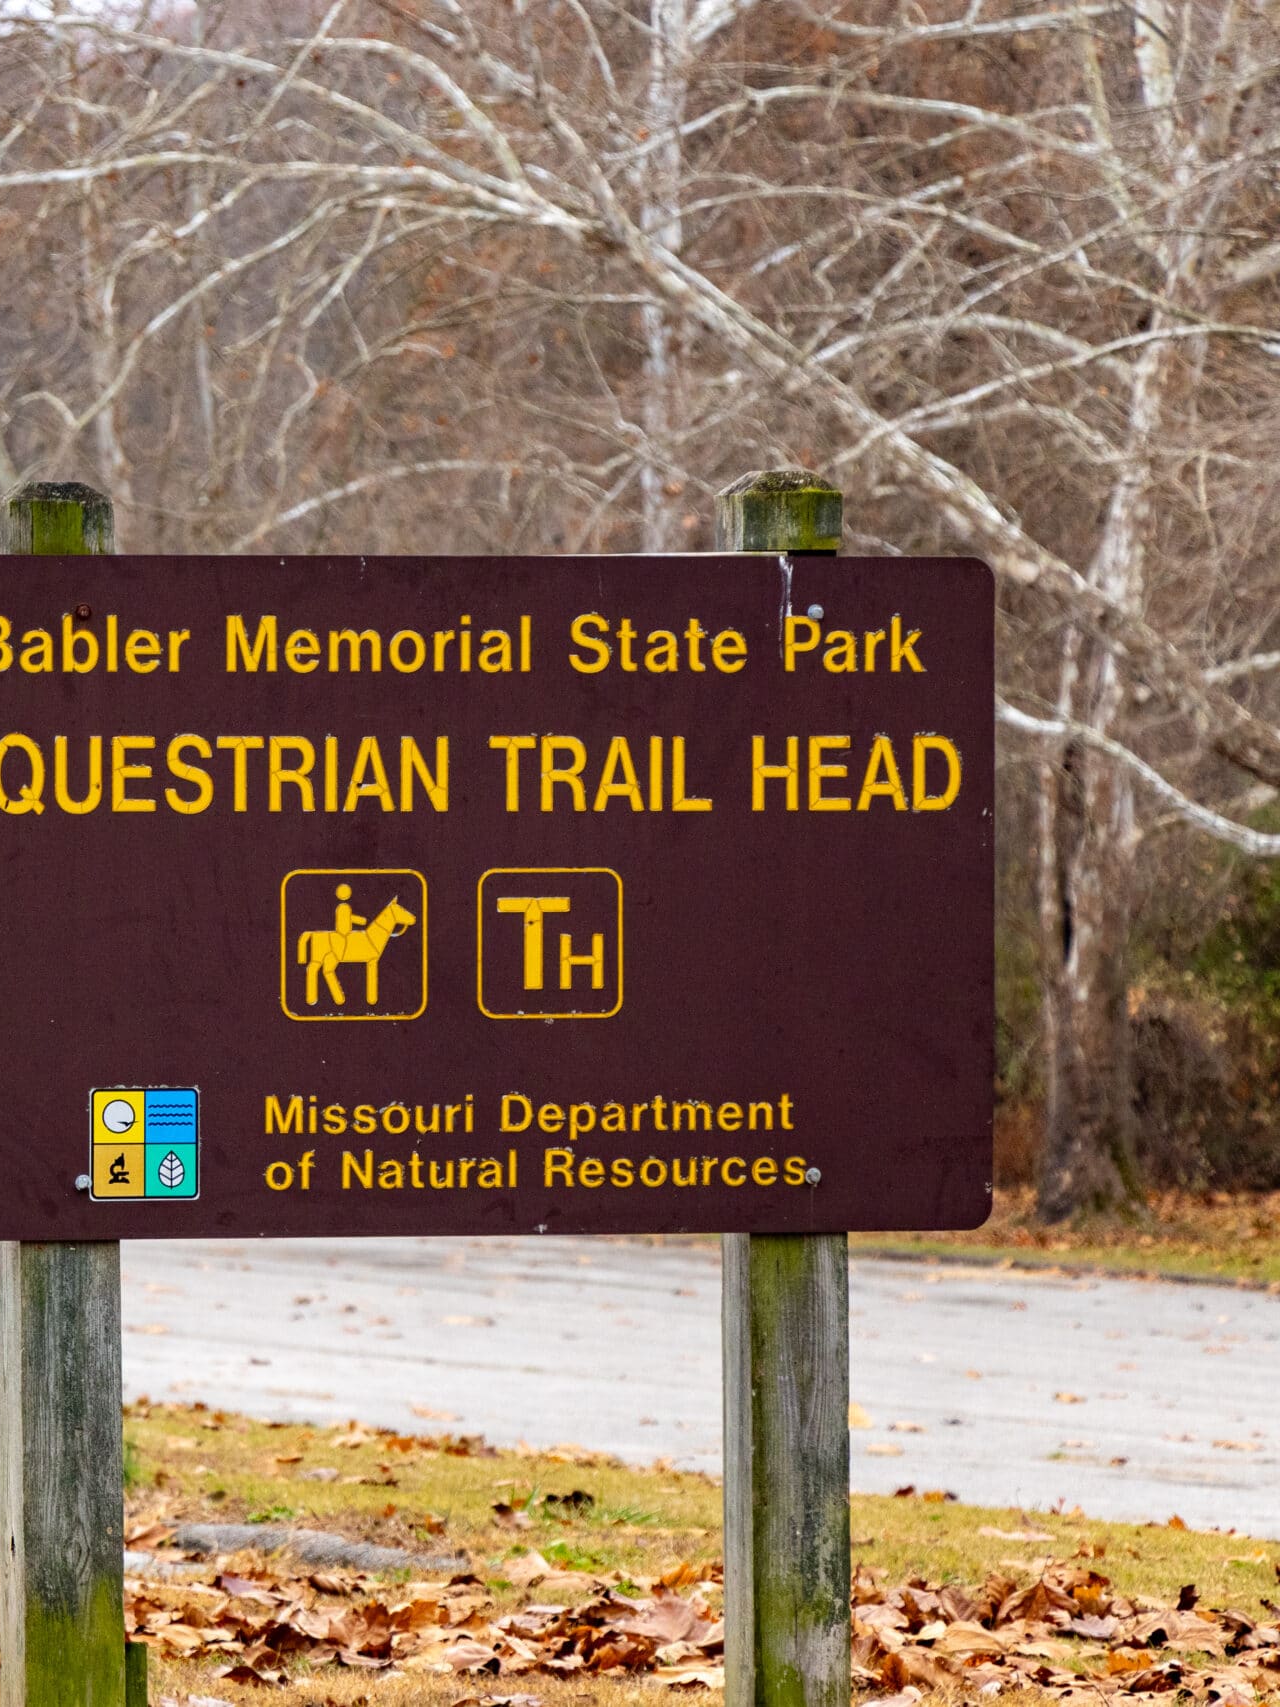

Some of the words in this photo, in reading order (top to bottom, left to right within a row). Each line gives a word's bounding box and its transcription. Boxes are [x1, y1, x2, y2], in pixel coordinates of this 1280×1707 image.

[225, 614, 532, 674] Memorial
[568, 613, 748, 674] State
[784, 615, 926, 674] Park
[488, 734, 713, 813] TRAIL
[751, 734, 962, 812] HEAD
[264, 1093, 475, 1135] Missouri
[500, 1093, 795, 1141] Department
[264, 1150, 317, 1191] of
[341, 1149, 518, 1190] Natural
[543, 1148, 807, 1189] Resources
